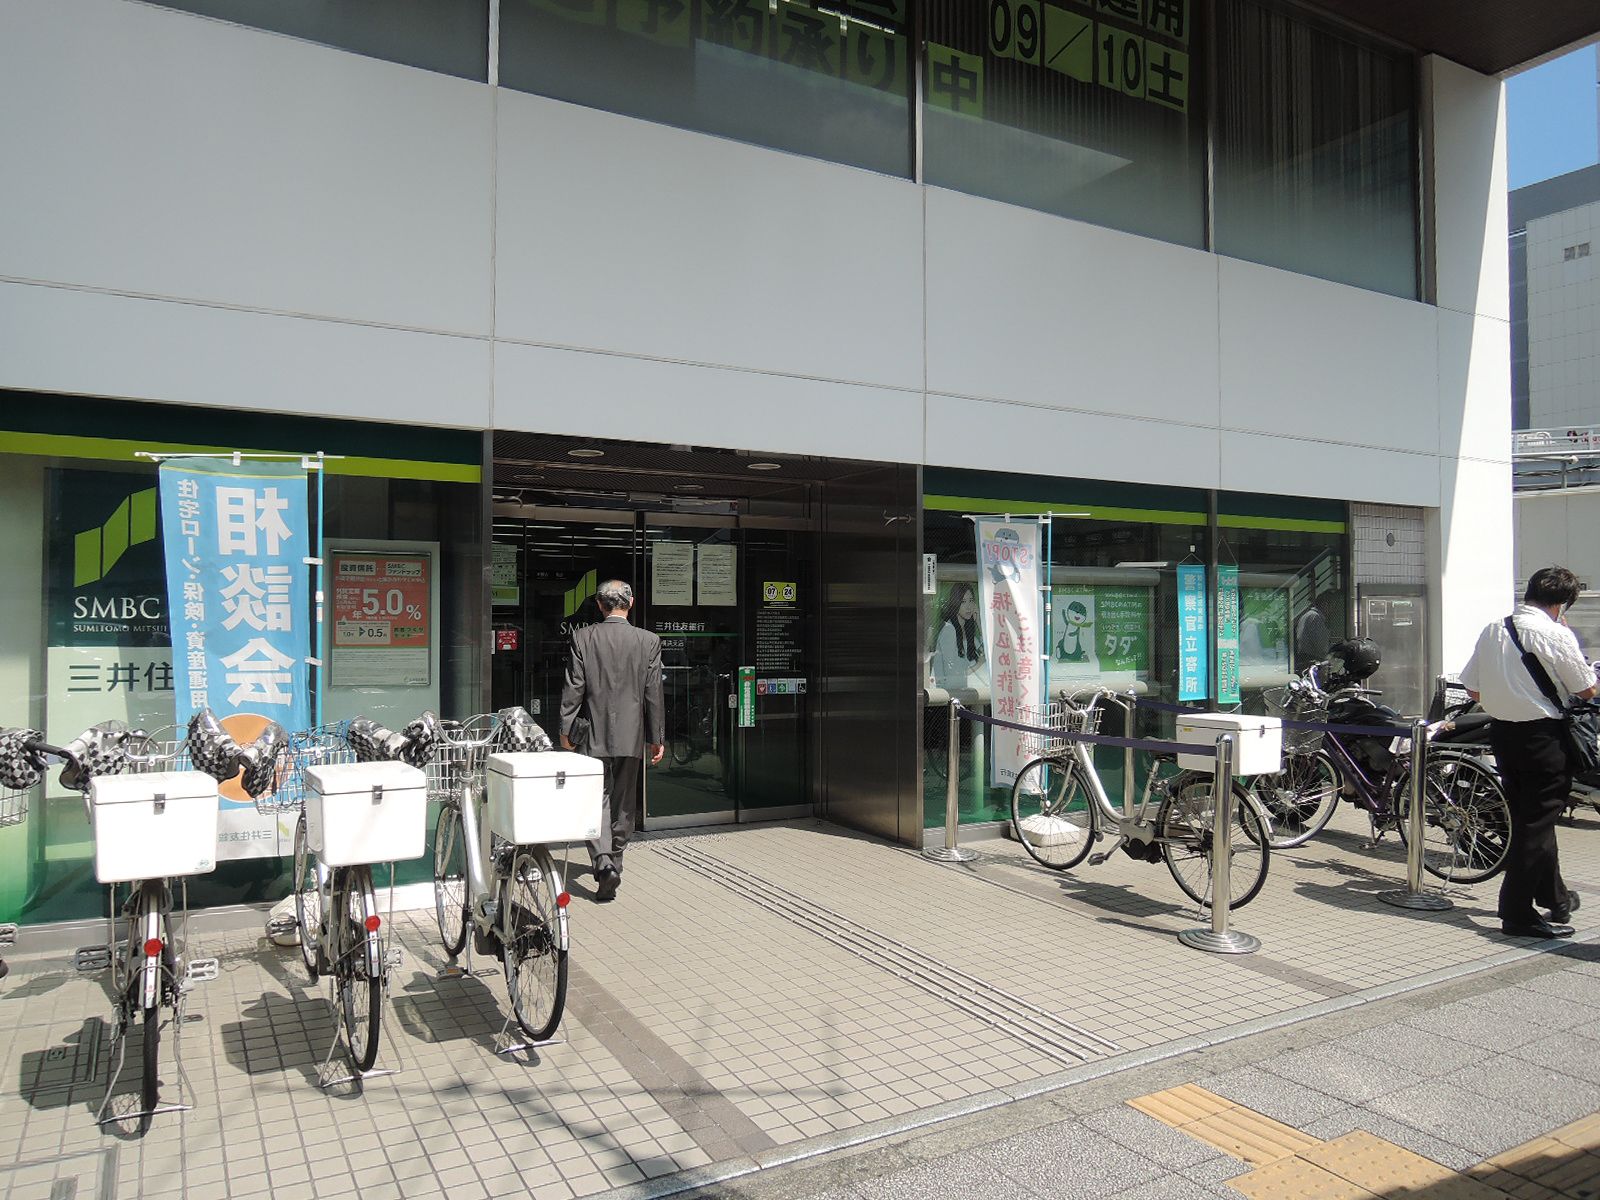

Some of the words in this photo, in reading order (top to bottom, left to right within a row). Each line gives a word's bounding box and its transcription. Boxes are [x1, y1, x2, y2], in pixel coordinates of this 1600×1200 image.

[73, 596, 160, 619] SMBC
[73, 624, 129, 633] SUMITOMO
[656, 622, 705, 631] 三井住友銀行
